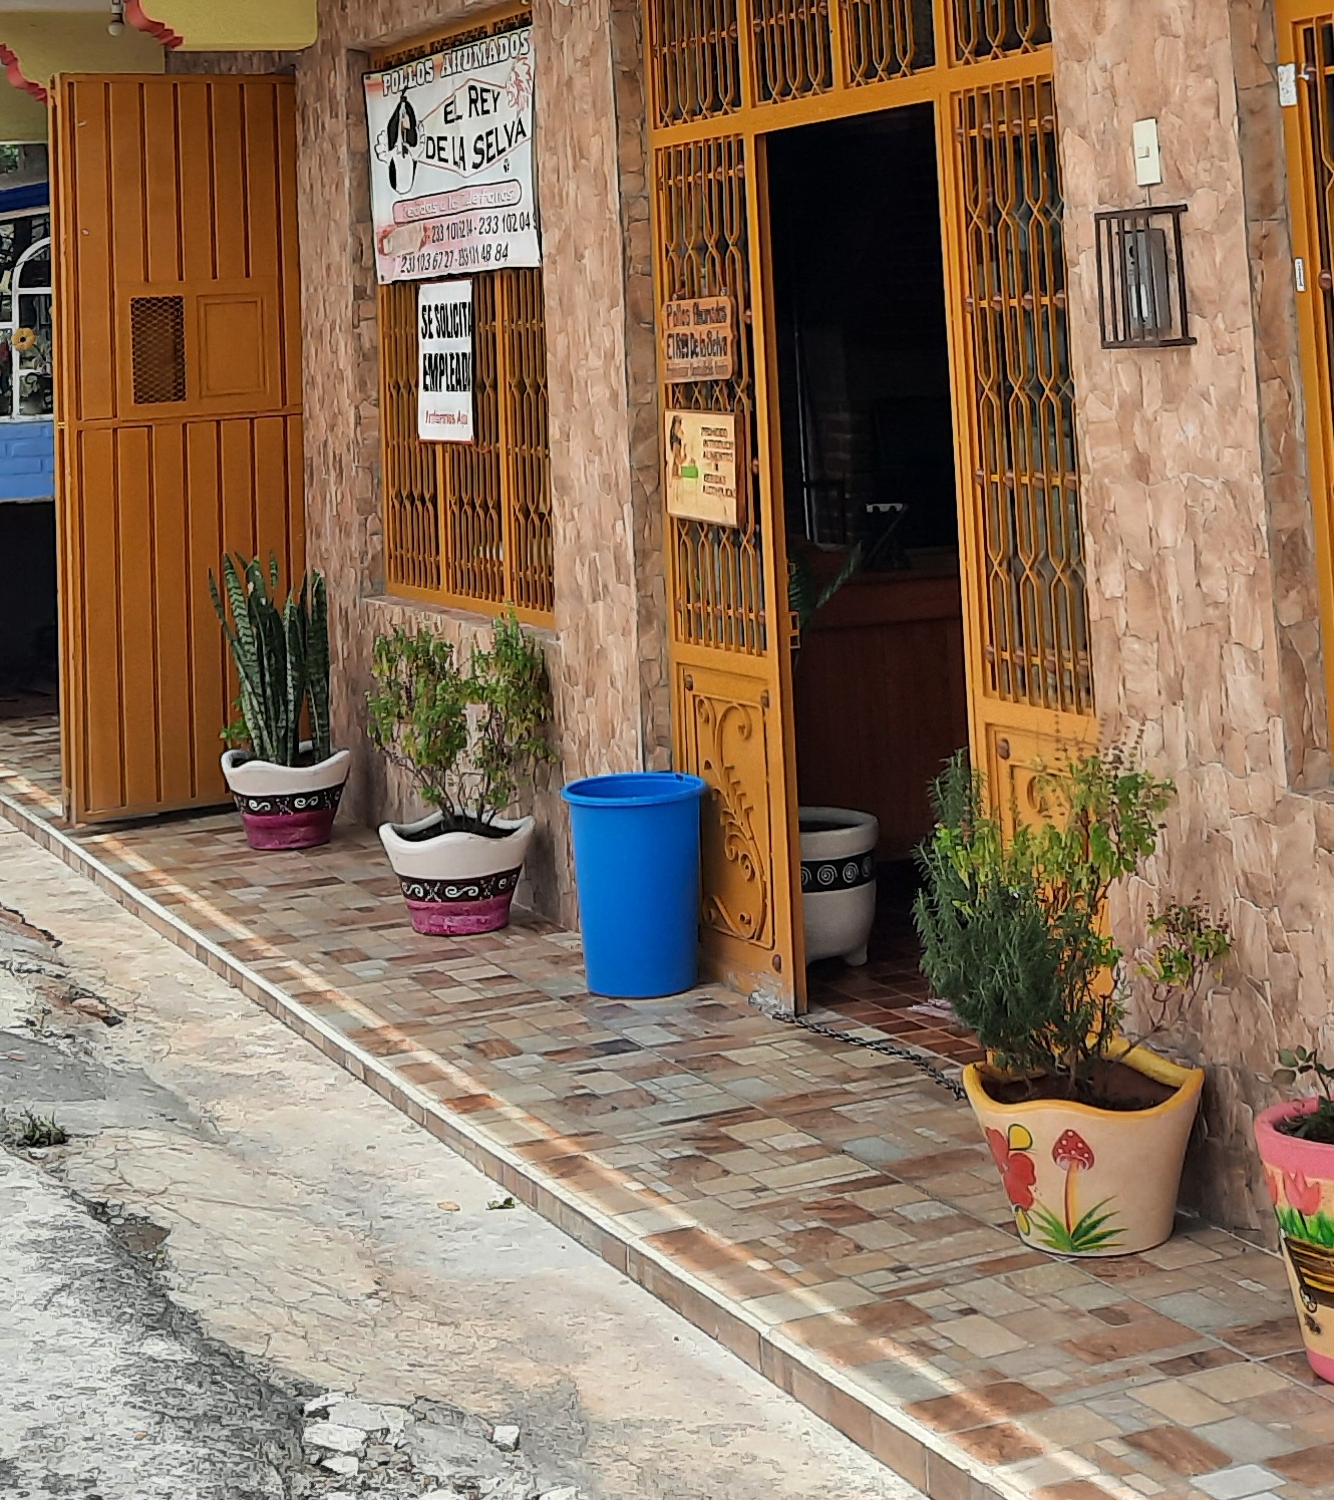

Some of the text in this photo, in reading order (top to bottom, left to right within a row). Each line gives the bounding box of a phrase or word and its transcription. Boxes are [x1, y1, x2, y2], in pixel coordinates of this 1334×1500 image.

[382, 29, 531, 97] POLLOS AHUMADOS
[444, 85, 500, 124] EL REY
[426, 117, 527, 171] DE LA SELVA
[478, 215, 499, 236] 233
[421, 303, 434, 339] SE
